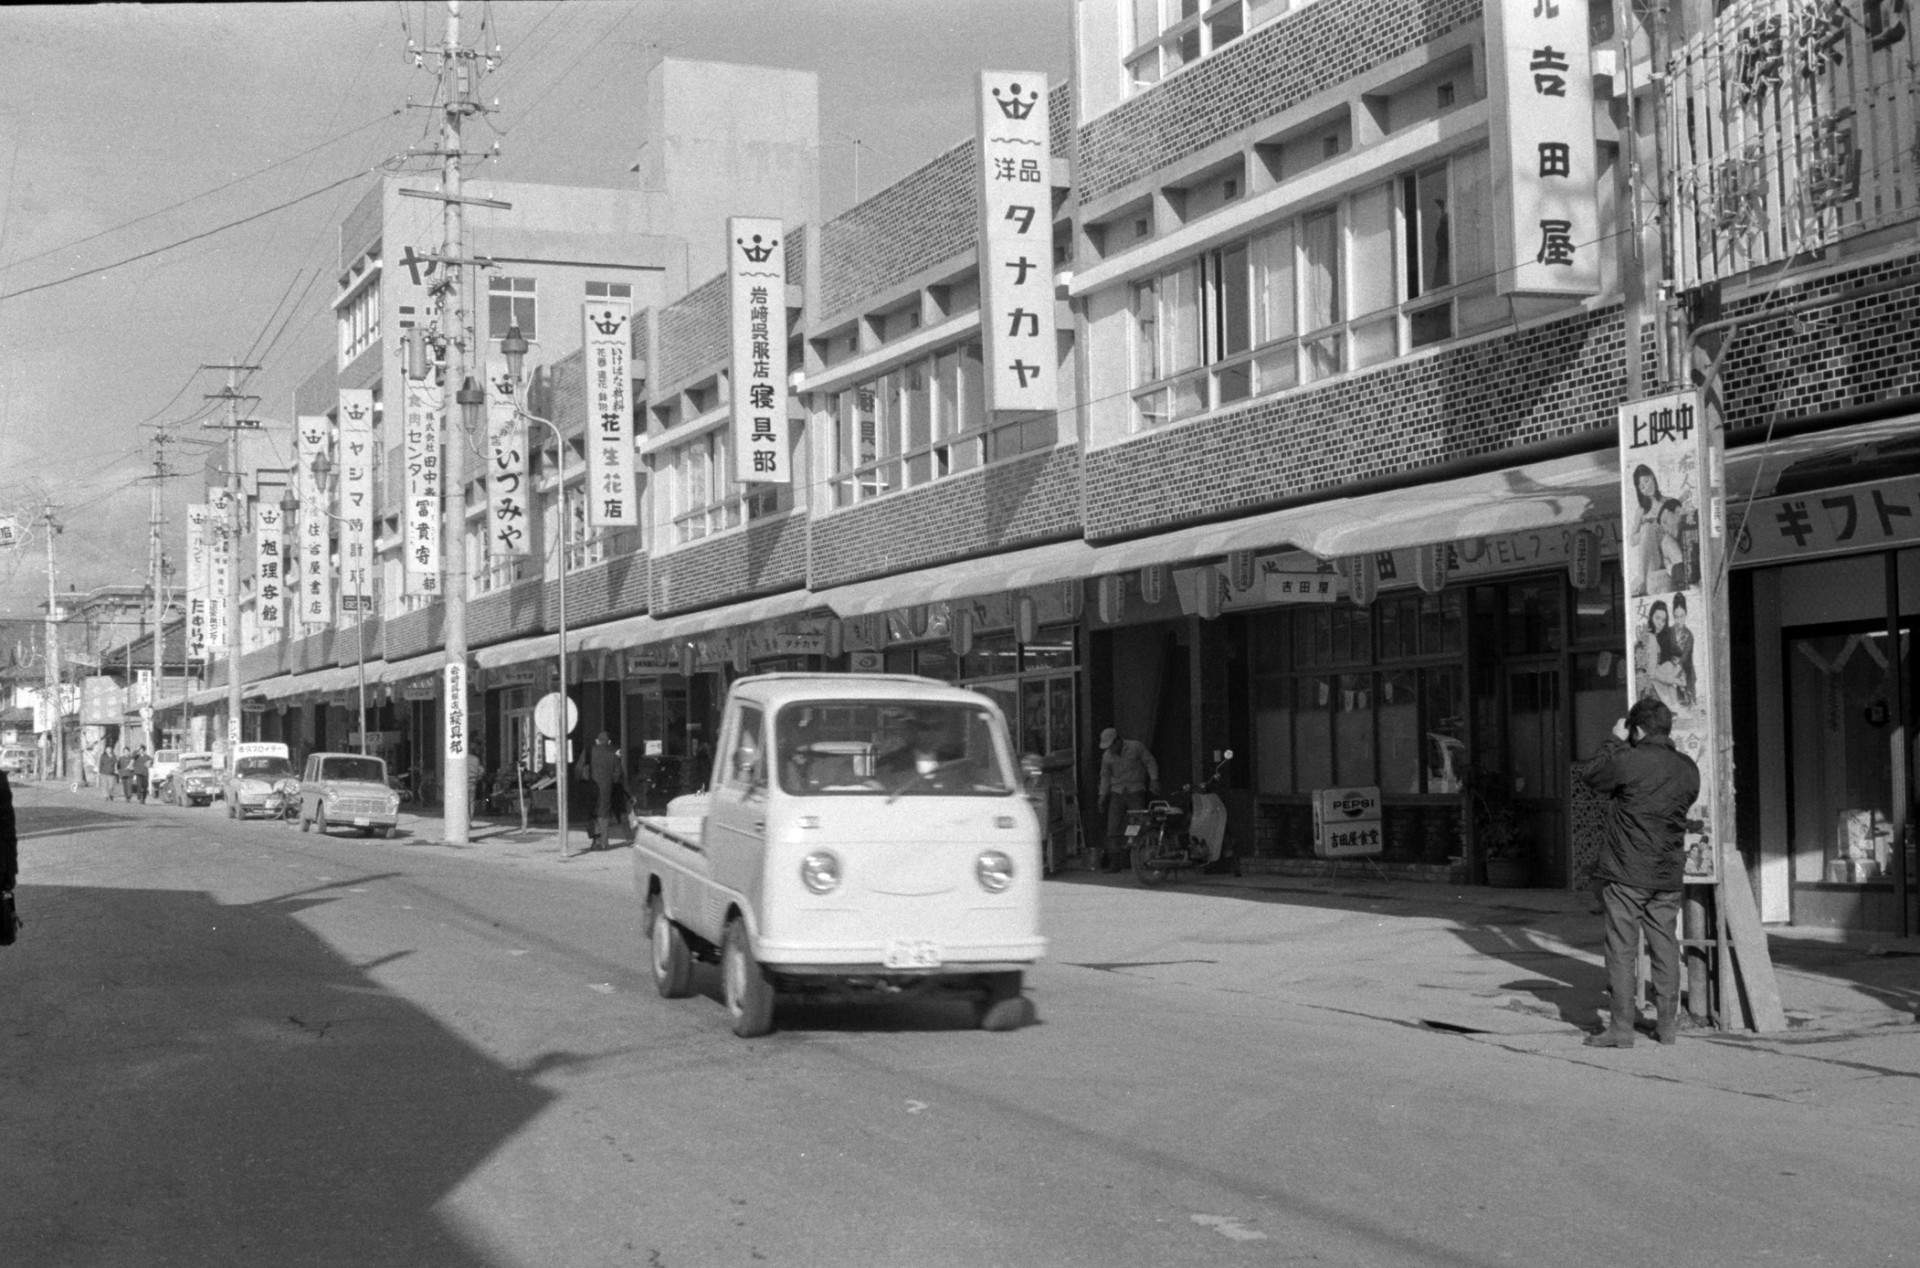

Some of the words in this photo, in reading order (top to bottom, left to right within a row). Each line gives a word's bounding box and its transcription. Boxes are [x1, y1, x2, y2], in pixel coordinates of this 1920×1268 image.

[994, 157, 1041, 183] 洋品
[1530, 45, 1575, 266] 吉田屋
[1004, 204, 1041, 389] タナカヤ
[407, 394, 422, 494] 食肉センター
[1629, 403, 1694, 449] 上映中
[495, 448, 523, 550] いづみや
[601, 413, 622, 519] 花一生花店
[1775, 490, 1912, 546] ギフト
[261, 539, 278, 621] 旭理容館
[1282, 580, 1329, 593] 吉田屋
[1330, 829, 1379, 848] 吉田屋食堂
[1333, 799, 1374, 810] PEPSI
